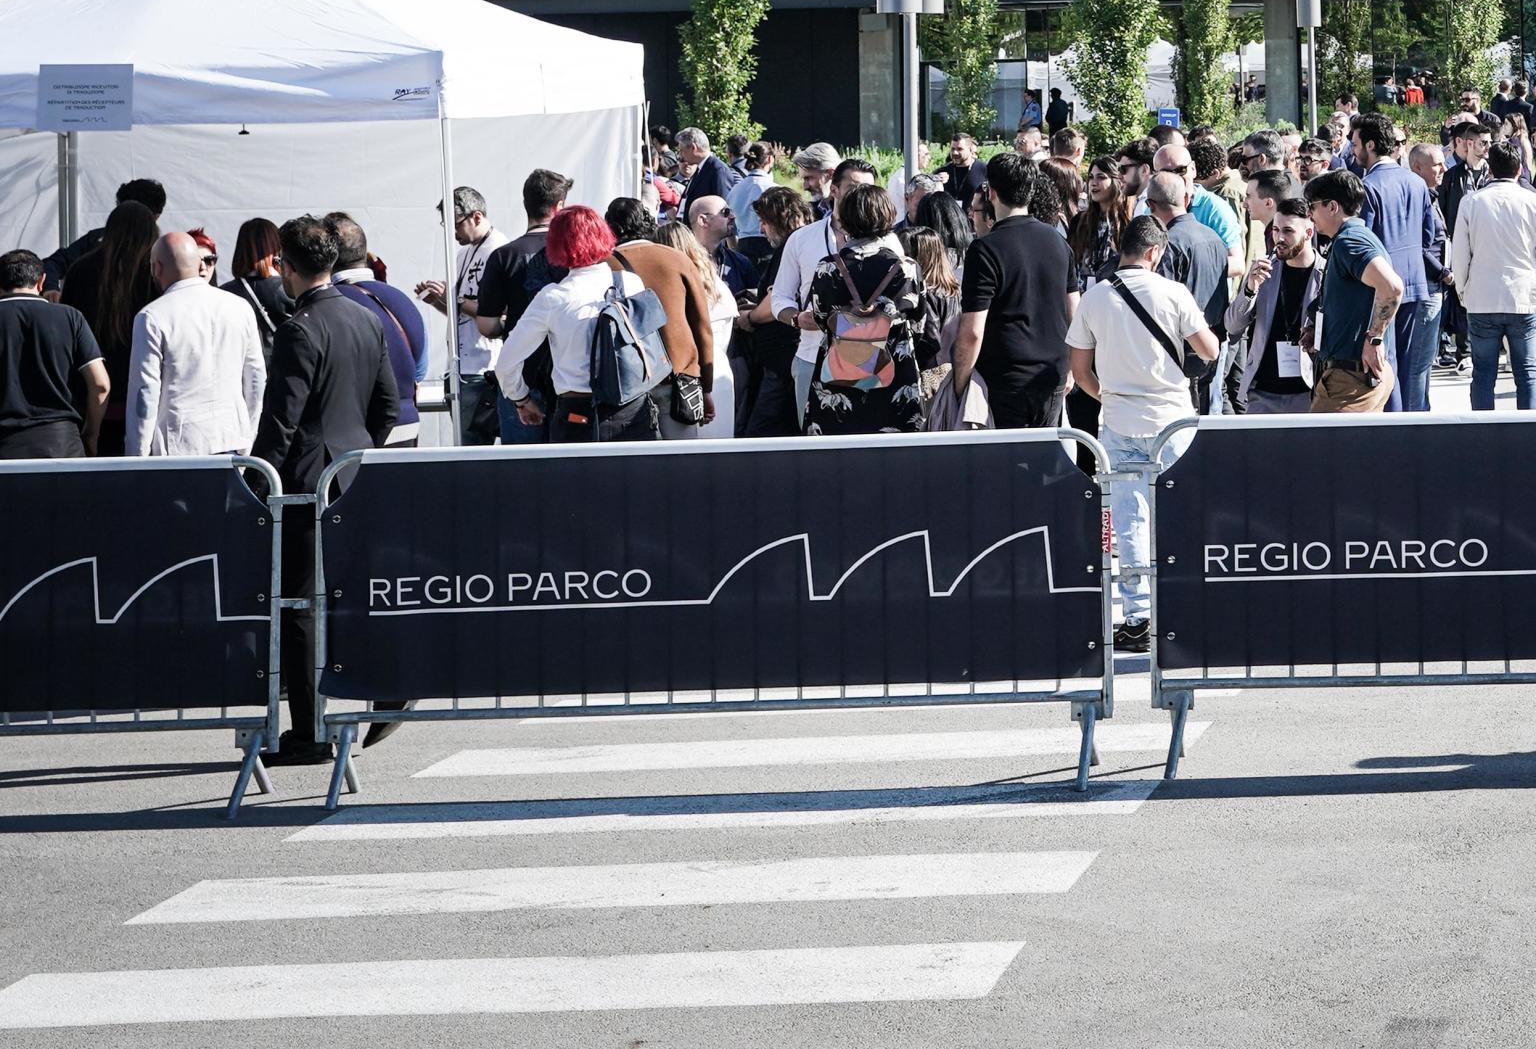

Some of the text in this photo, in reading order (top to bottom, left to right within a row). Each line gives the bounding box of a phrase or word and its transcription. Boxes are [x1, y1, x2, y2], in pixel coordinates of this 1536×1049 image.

[1101, 511, 1109, 553] ALTRAD
[1204, 538, 1489, 572] REGIO PARCO
[369, 569, 652, 607] REGIO PARCO
